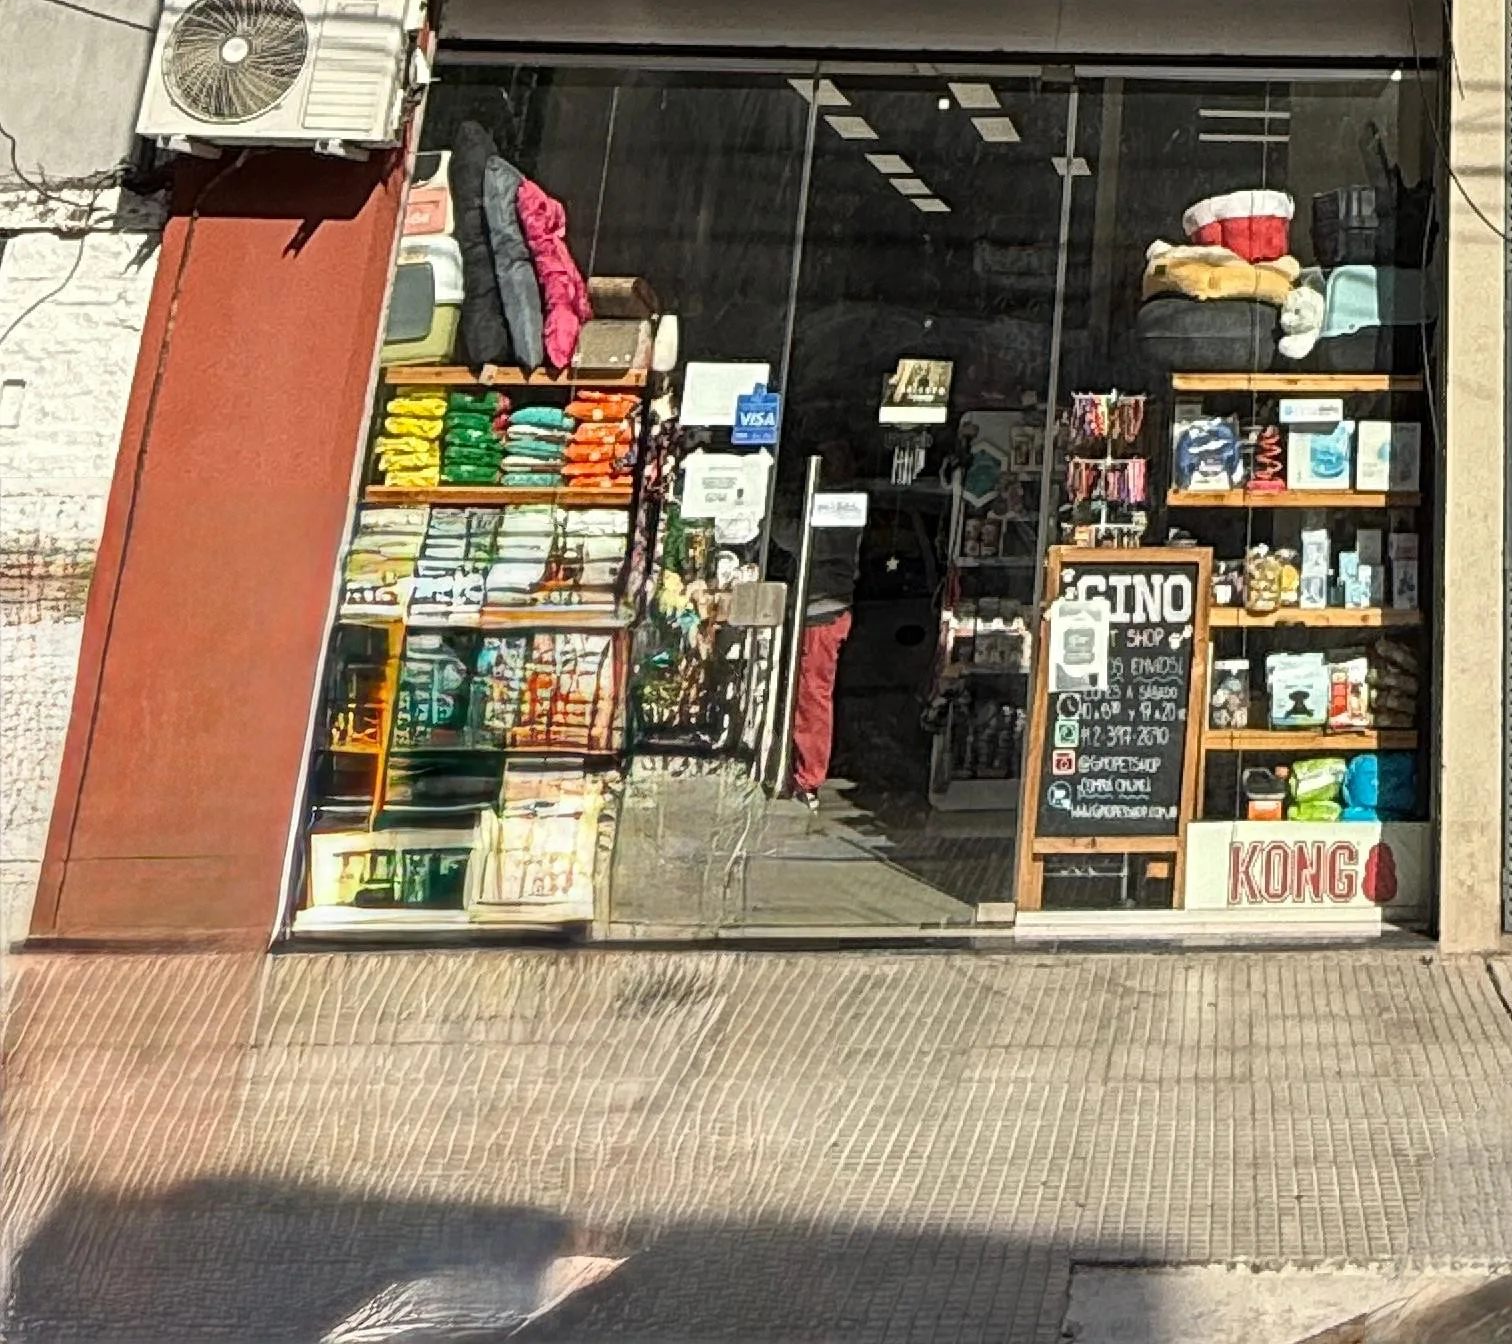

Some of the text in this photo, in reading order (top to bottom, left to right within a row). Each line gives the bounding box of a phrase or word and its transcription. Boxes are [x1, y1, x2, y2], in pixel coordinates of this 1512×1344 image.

[740, 412, 776, 426] VISA
[1126, 627, 1165, 648] SHOP
[1229, 841, 1359, 904] KONG
